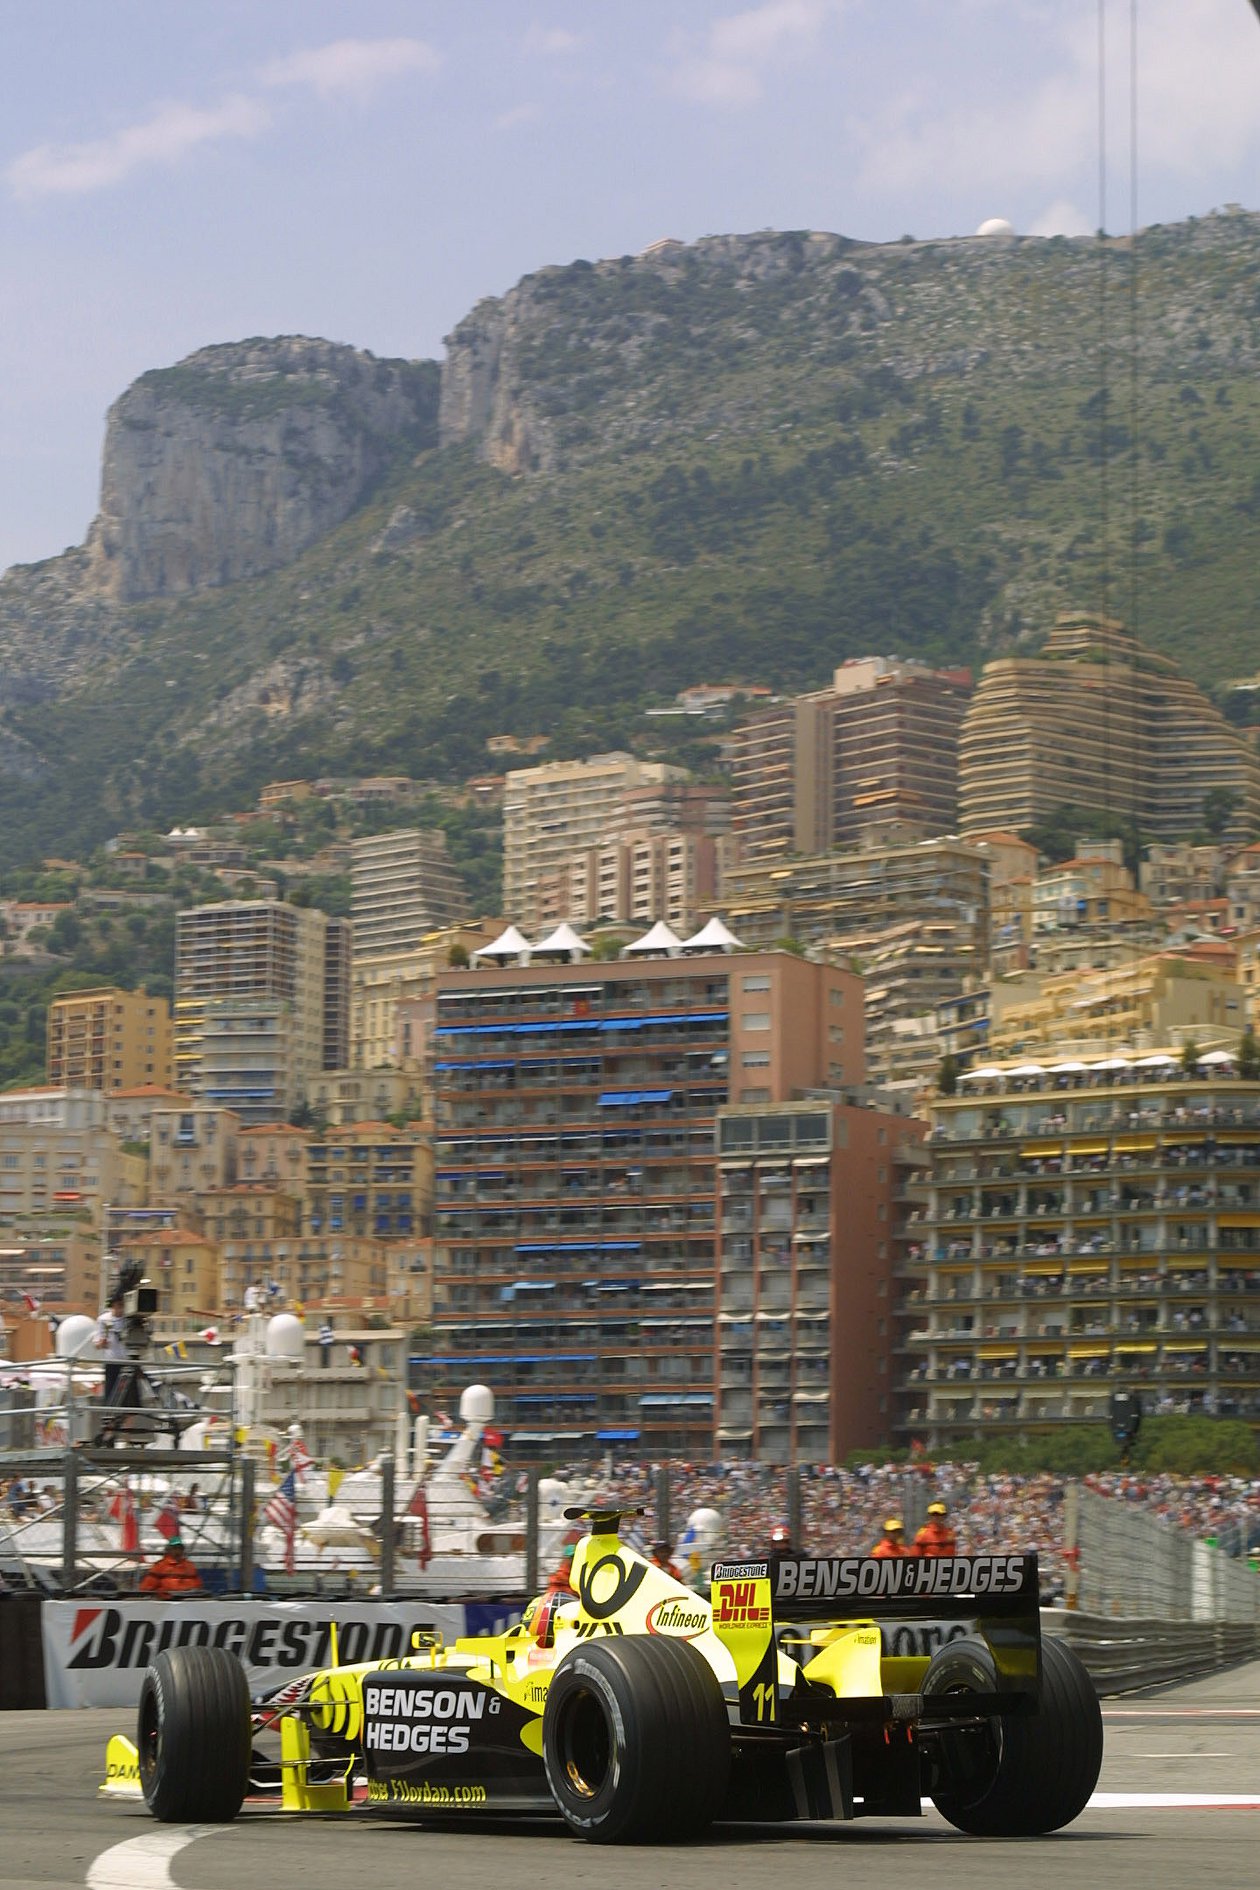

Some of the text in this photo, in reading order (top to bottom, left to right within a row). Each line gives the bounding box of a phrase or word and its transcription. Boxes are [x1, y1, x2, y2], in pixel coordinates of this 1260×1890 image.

[715, 1564, 766, 1579] BRIDGESTONE
[656, 1605, 707, 1629] Infineon
[719, 1583, 760, 1622] DHL
[366, 1688, 501, 1719] BENSON &
[752, 1683, 775, 1722] 11
[367, 1723, 470, 1753] HEDGES
